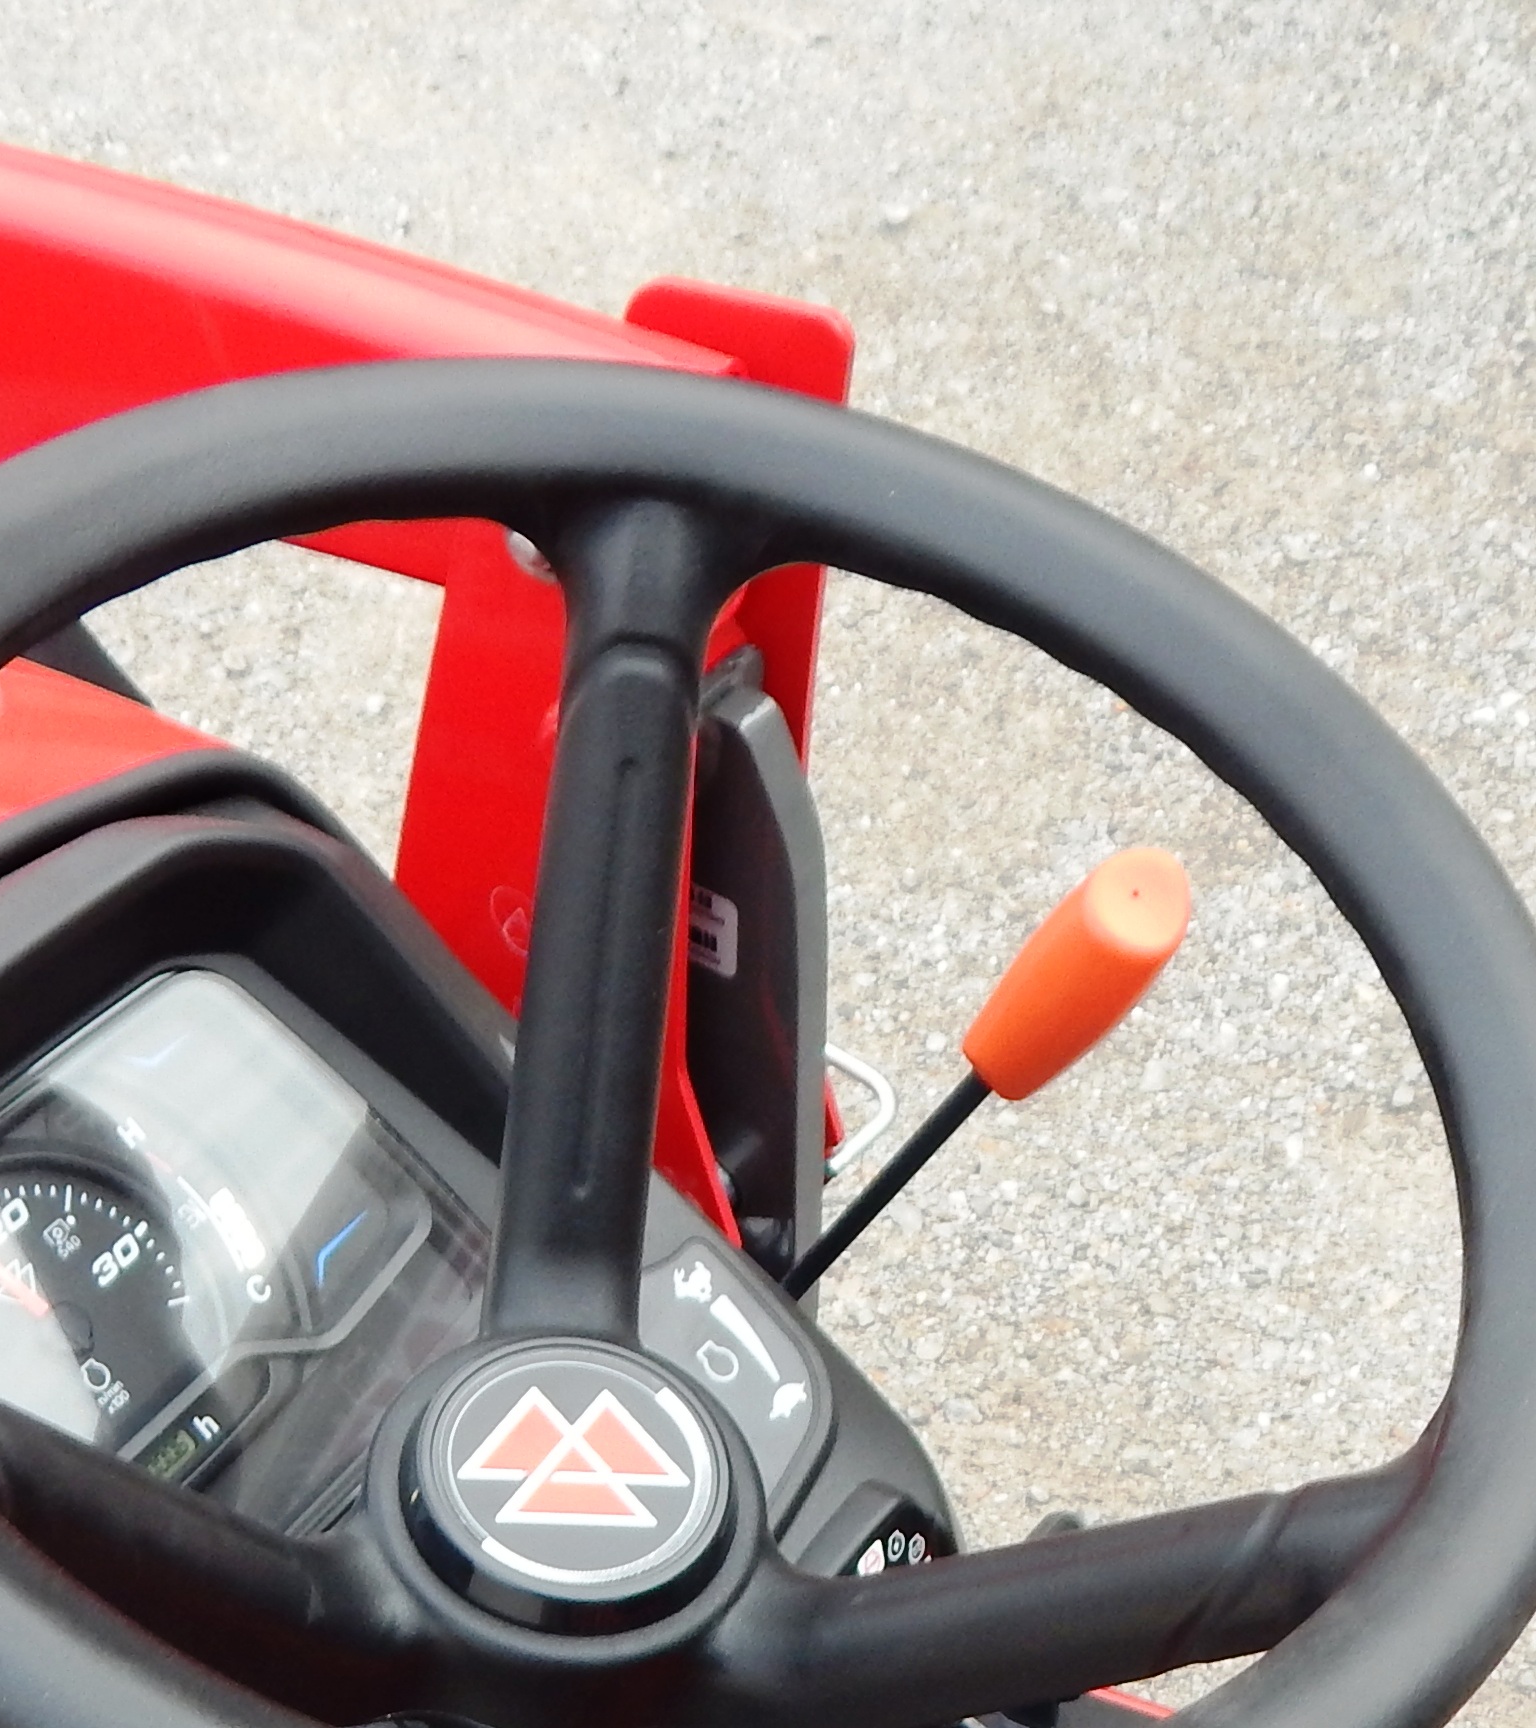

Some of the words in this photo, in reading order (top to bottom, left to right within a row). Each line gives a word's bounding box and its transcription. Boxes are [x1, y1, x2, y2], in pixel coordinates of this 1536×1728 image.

[117, 1116, 146, 1149] H
[92, 1233, 140, 1288] 30
[246, 1274, 271, 1303] C
[192, 1414, 221, 1441] h
